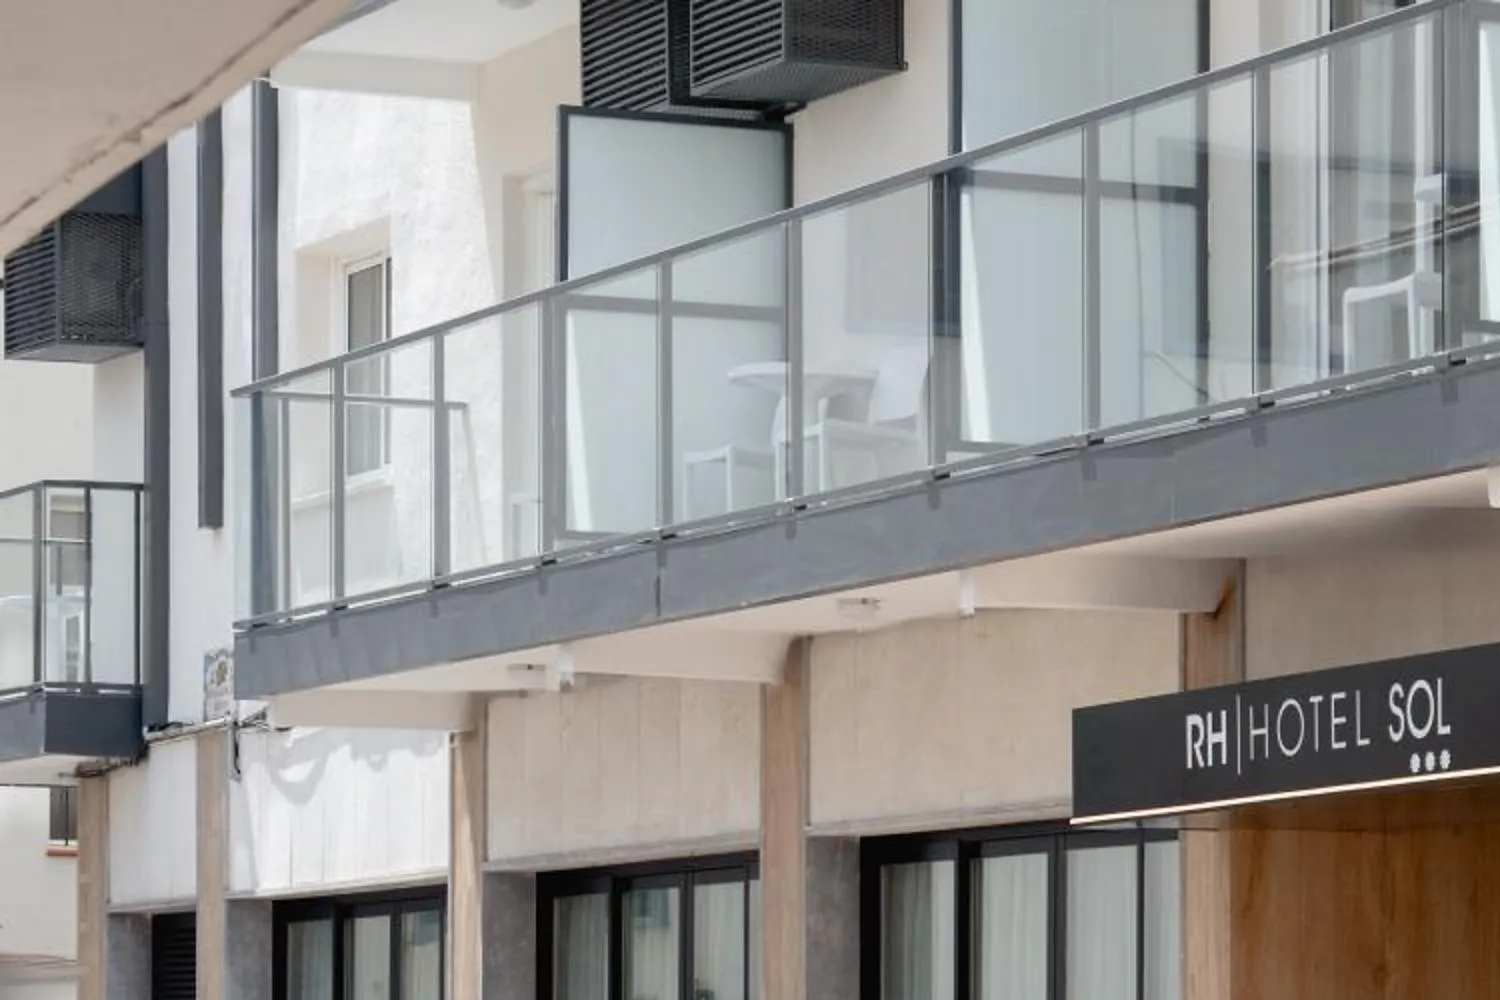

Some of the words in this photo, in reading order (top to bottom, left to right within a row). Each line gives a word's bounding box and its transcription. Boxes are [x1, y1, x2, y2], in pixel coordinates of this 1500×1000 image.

[1186, 709, 1227, 769] RH
[1249, 690, 1371, 761] HOTEL
[1388, 677, 1451, 742] SOL
